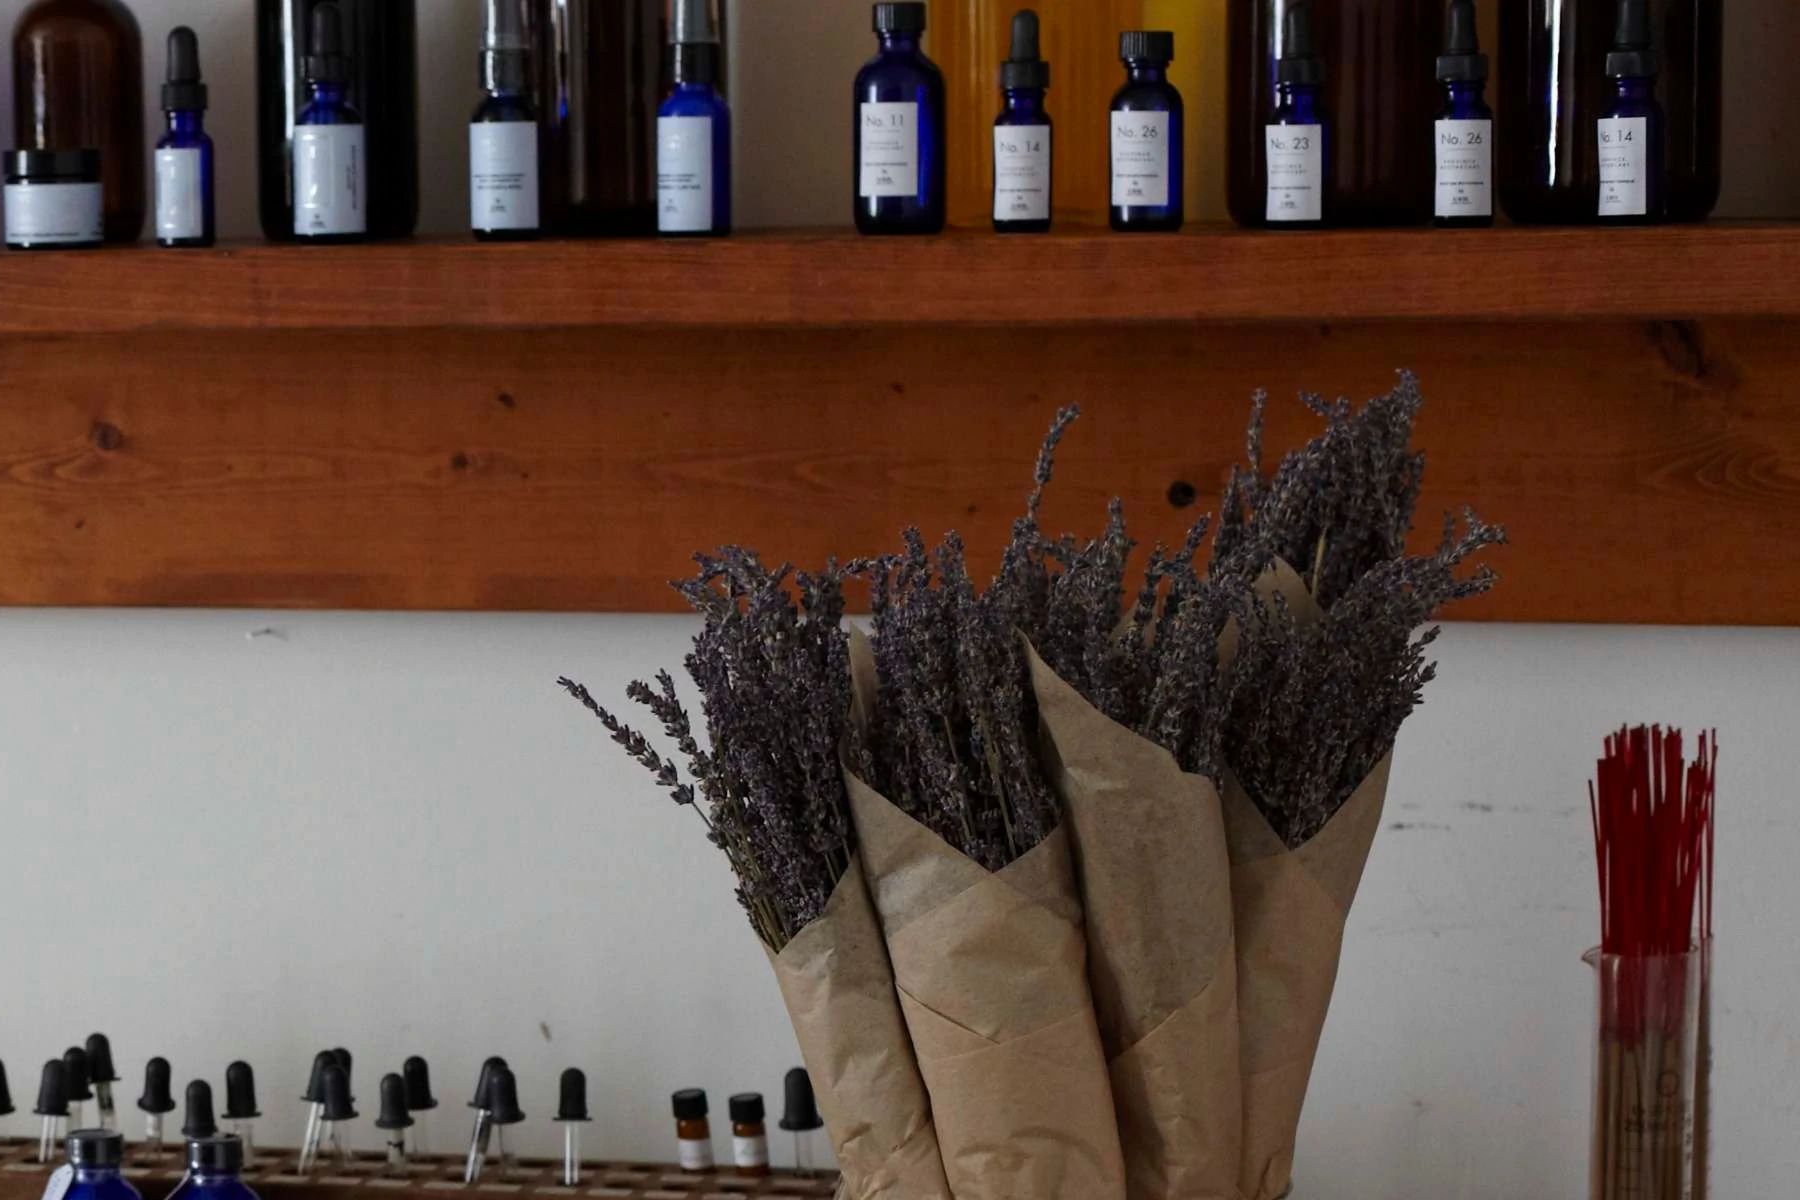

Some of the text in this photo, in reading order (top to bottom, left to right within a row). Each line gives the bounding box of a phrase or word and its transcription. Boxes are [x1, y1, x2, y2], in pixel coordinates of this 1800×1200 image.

[890, 114, 904, 127] 11
[1117, 125, 1158, 137] No. 26
[1616, 130, 1633, 143] 14
[1270, 137, 1310, 150] No. 23
[1440, 132, 1483, 145] No. 26
[1025, 141, 1041, 152] 14
